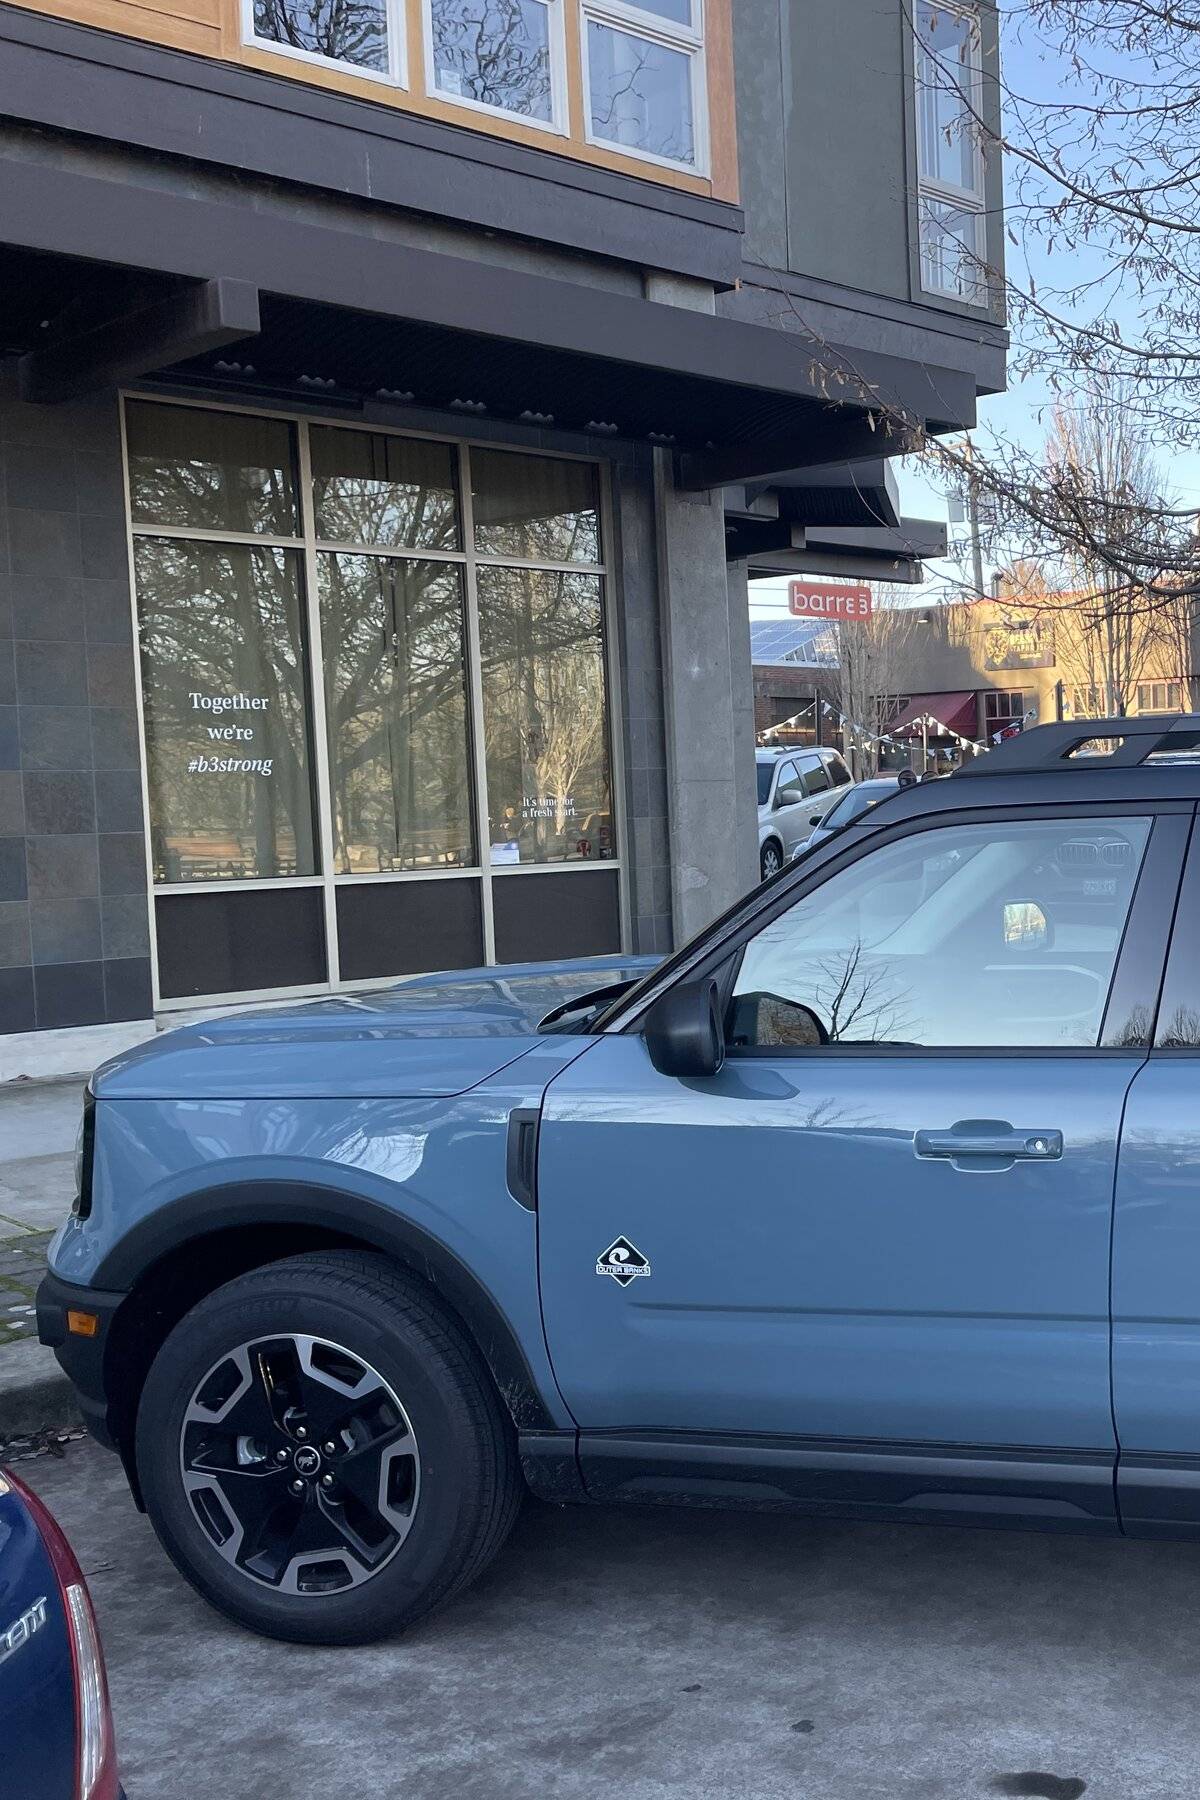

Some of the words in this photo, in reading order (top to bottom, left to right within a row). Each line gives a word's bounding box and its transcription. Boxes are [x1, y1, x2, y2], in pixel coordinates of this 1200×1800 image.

[188, 692, 269, 714] Together
[187, 755, 273, 776] #b3strong
[523, 797, 537, 807] It's
[561, 798, 574, 806] or
[522, 810, 528, 818] a
[530, 807, 553, 818] fresh
[554, 807, 578, 817] sart.
